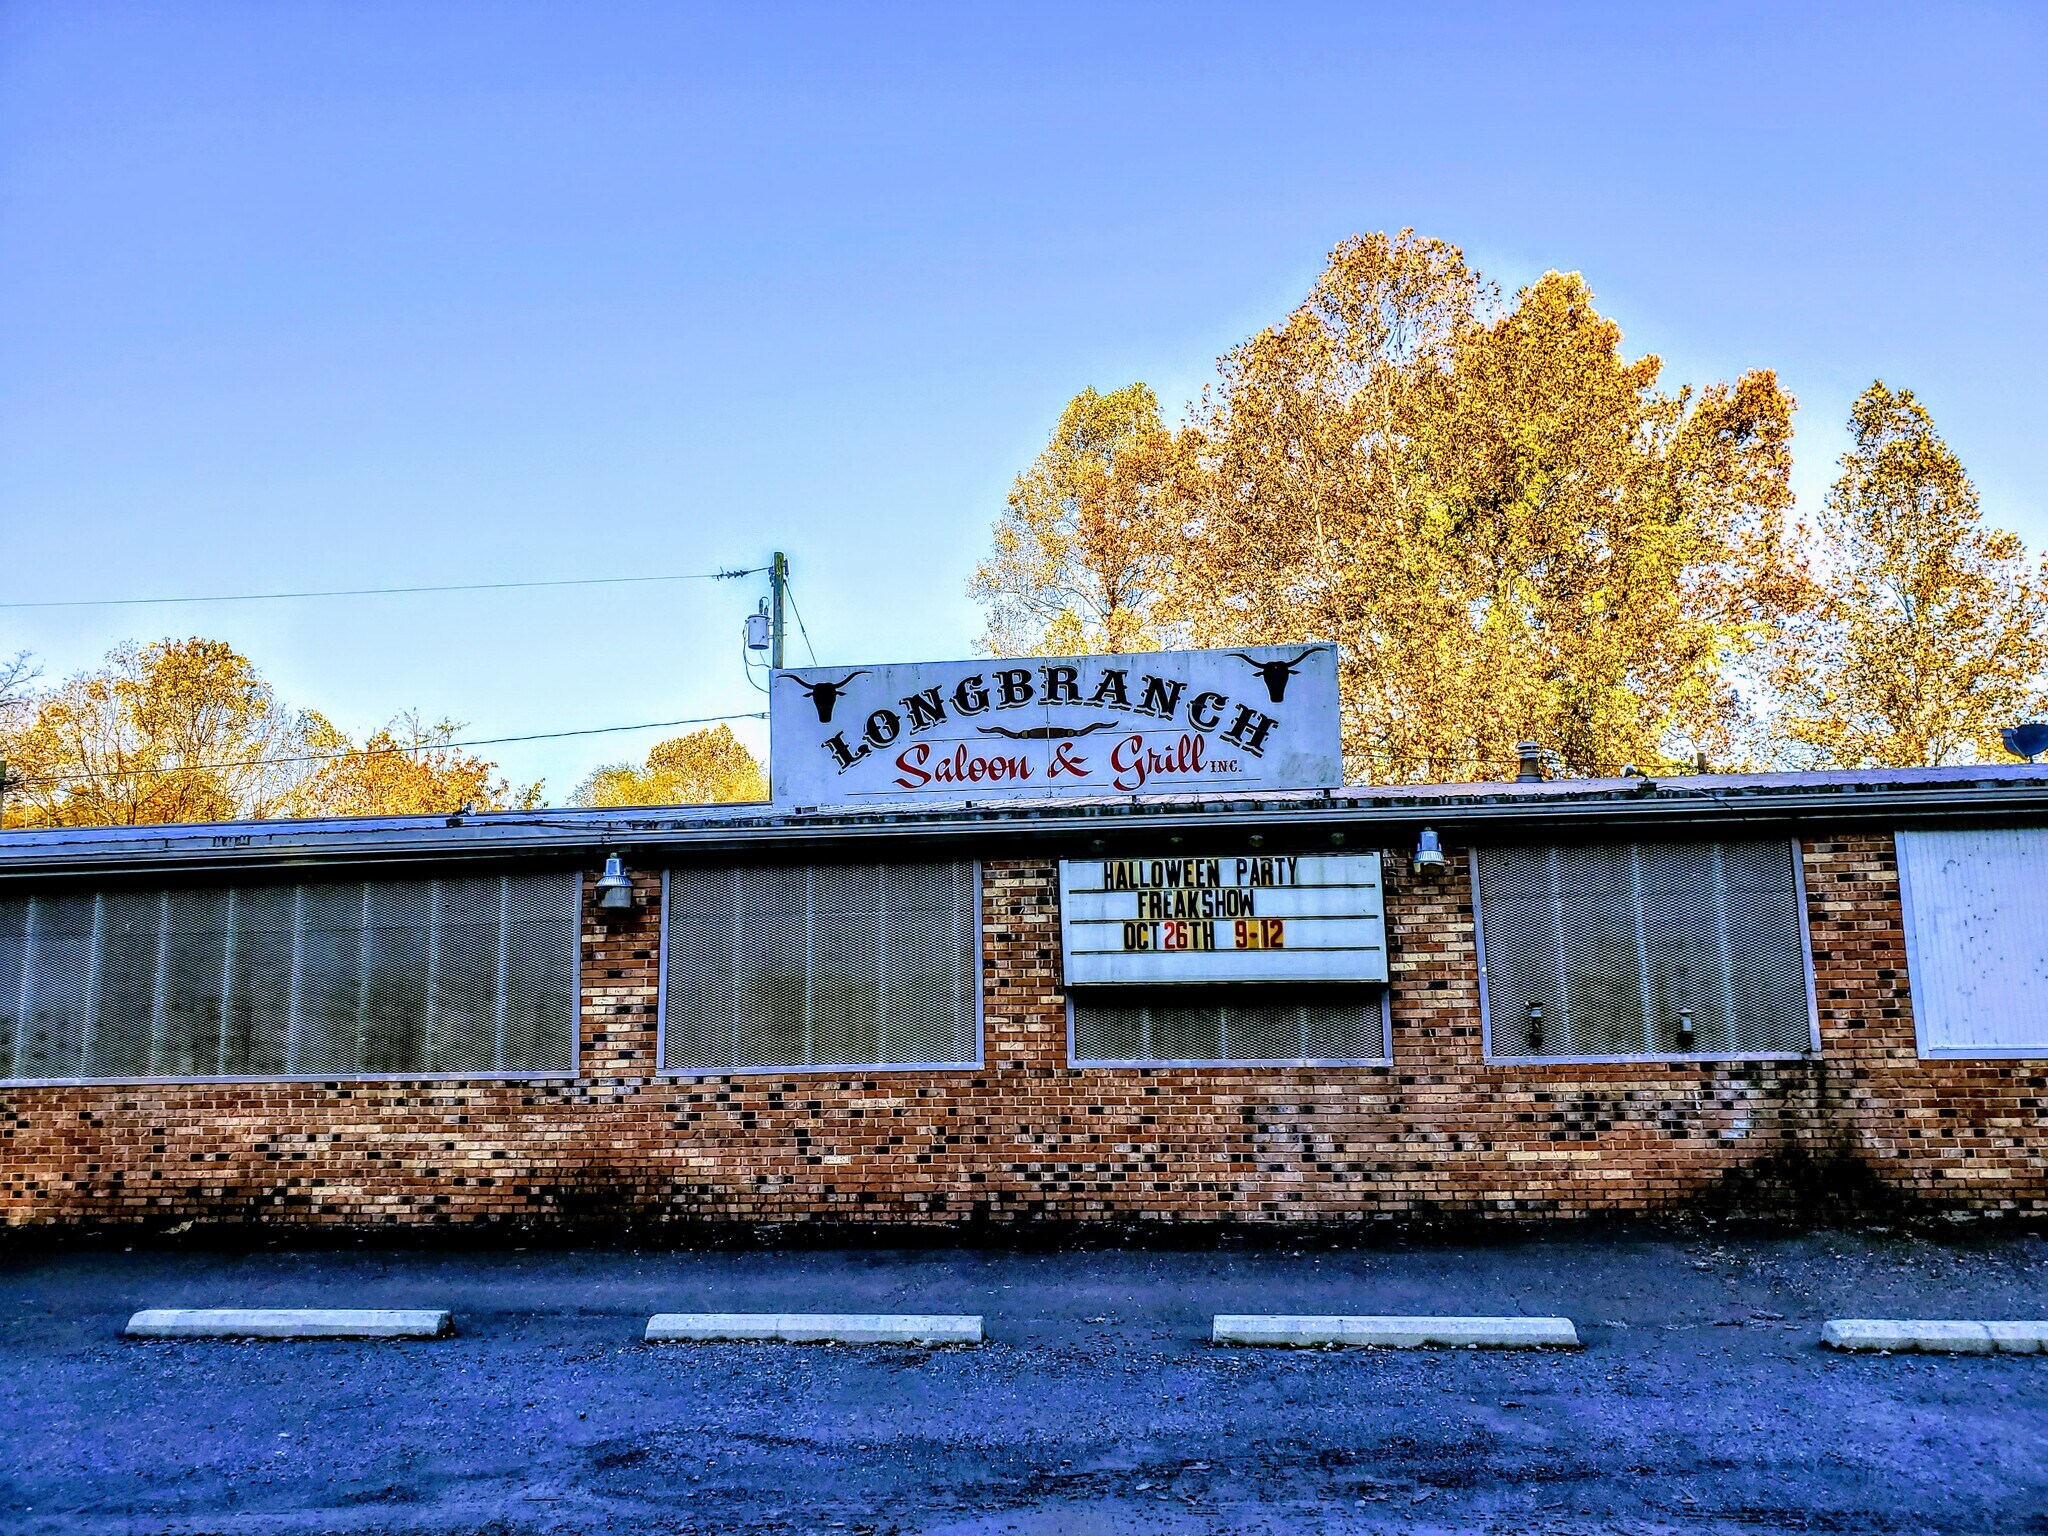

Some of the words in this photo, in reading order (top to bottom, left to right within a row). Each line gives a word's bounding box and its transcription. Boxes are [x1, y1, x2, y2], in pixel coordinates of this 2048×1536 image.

[821, 666, 1279, 773] LONGBRANCH
[892, 737, 1034, 789] Saloon
[1047, 742, 1092, 777] &
[1111, 732, 1205, 790] Grill
[1210, 760, 1242, 773] INC.
[1104, 859, 1219, 889] HALLOWEEN
[1237, 857, 1297, 886] PARTY
[1138, 889, 1254, 918] FREAKSHOW
[1124, 921, 1160, 949] OCT
[1164, 921, 1214, 949] 26TH
[1235, 920, 1283, 948] 9-12
